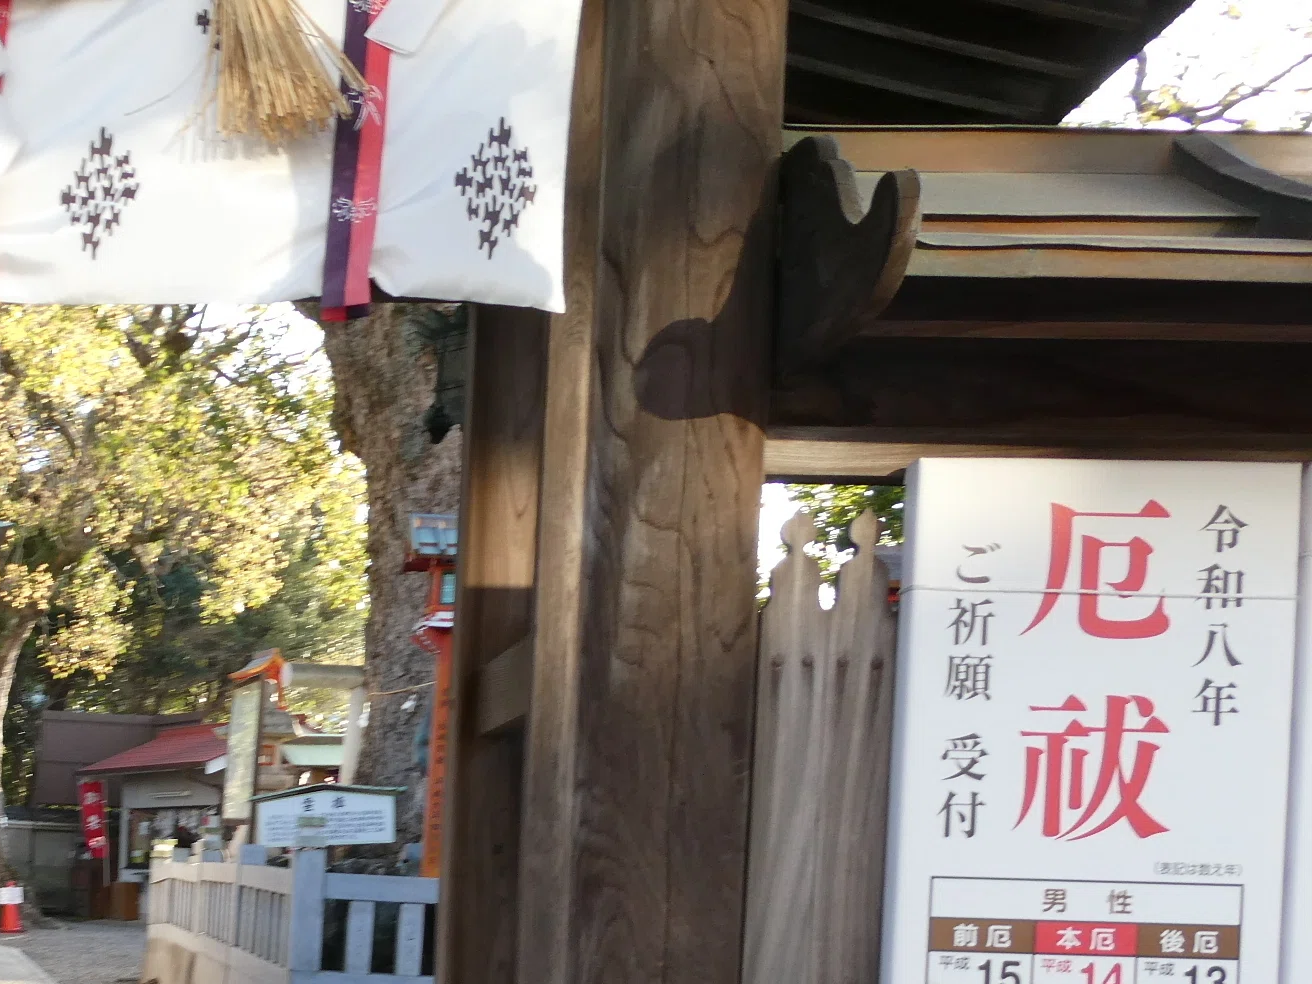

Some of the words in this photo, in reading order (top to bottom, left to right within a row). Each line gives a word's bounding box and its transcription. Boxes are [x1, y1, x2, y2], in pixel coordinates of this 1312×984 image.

[943, 542, 1000, 701] ご祈願
[1191, 504, 1248, 726] 令和八年
[1013, 499, 1170, 841] 厄祓
[937, 732, 987, 839] 受付
[1043, 889, 1133, 915] 男性
[952, 924, 1012, 948] 前厄
[1056, 927, 1115, 951] 本厄
[1160, 929, 1218, 954] 後厄
[939, 955, 968, 971] 平成
[1041, 959, 1071, 974] 平成
[1144, 962, 1173, 977] 平成
